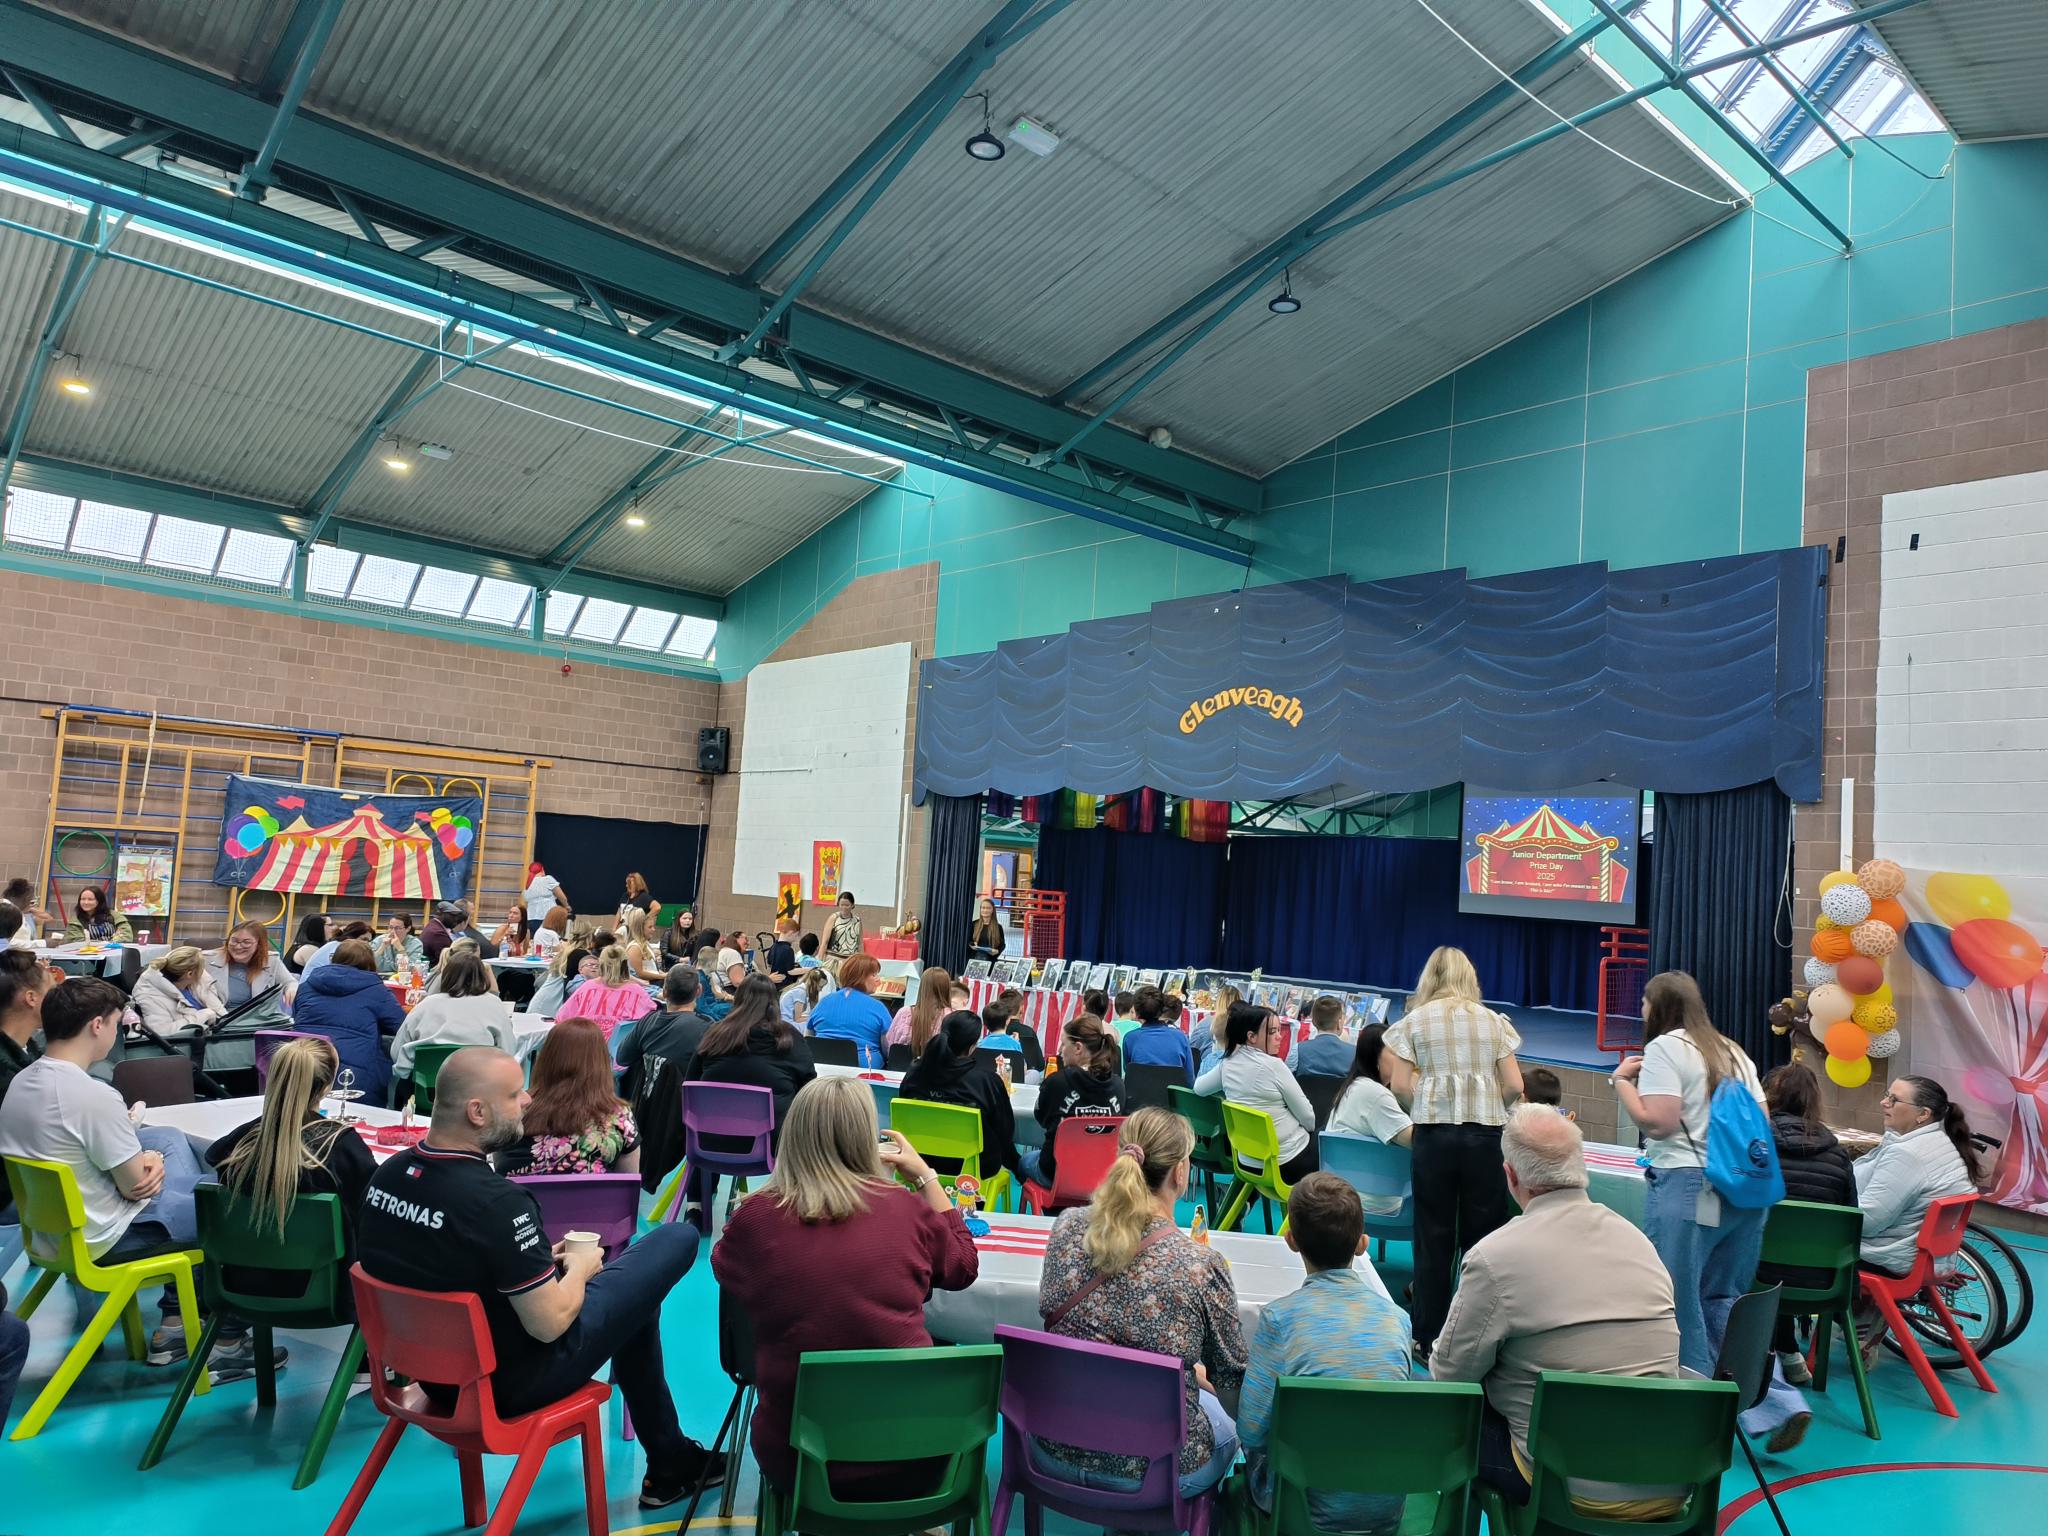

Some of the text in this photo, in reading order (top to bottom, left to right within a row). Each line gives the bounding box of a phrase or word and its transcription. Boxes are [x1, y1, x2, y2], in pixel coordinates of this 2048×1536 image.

[1179, 685, 1304, 735] Glenveagh
[1512, 851, 1582, 861] Junior Department
[1530, 861, 1564, 872] Prize Day
[1537, 872, 1556, 881] 2025
[1059, 1090, 1081, 1114] LAS
[366, 1186, 445, 1230] PETRONAS
[512, 1212, 531, 1228] IWC
